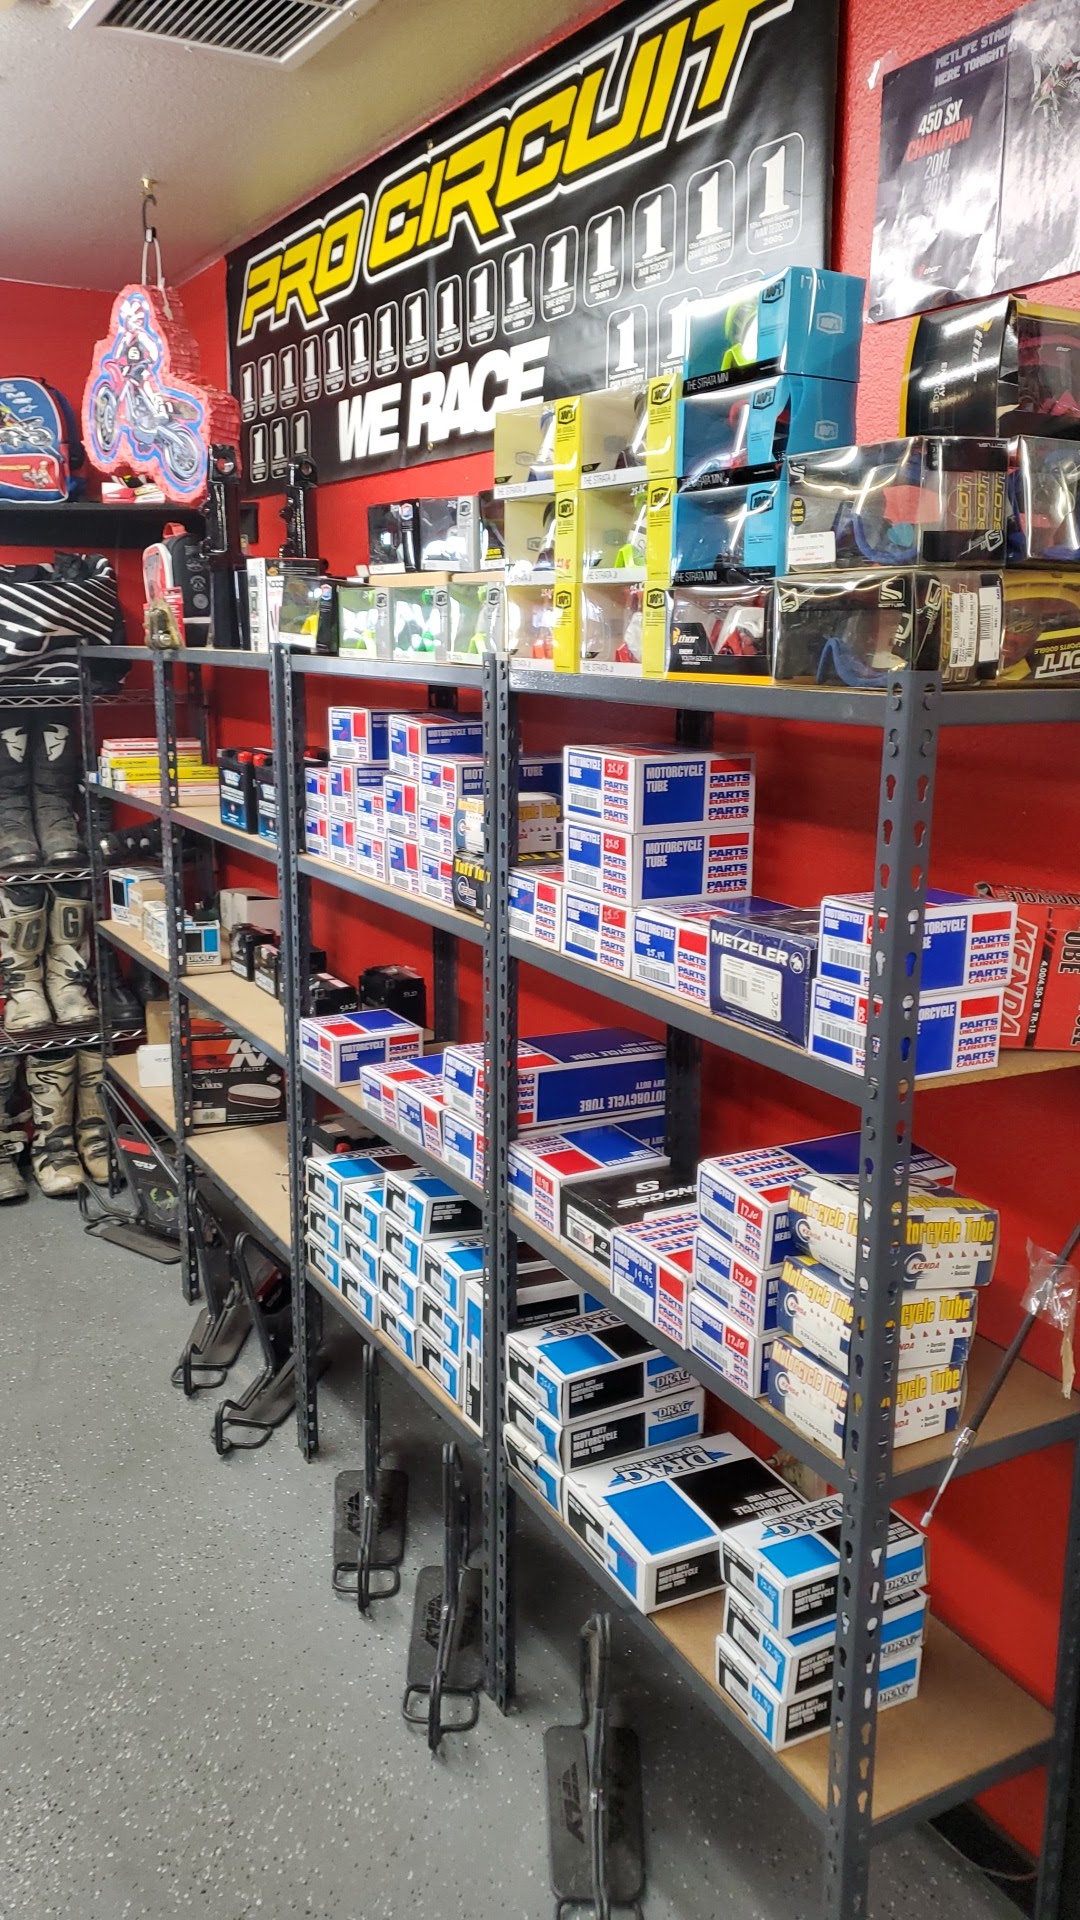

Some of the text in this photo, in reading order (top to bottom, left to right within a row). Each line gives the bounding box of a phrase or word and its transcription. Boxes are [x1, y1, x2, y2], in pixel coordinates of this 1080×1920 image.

[964, 44, 1006, 74] TONIGHT
[918, 99, 963, 136] 450 SX
[906, 117, 973, 161] CHAMPION
[238, 0, 792, 343] PRO CIRCUIT
[924, 149, 951, 180] 2014
[759, 146, 790, 218] 1
[696, 171, 723, 239] 1
[642, 195, 665, 258] 1
[593, 216, 615, 276] 1
[548, 235, 568, 292] 1
[509, 252, 528, 307] 1
[474, 268, 490, 320] 1
[441, 283, 456, 332] 1
[409, 296, 424, 343] 1
[380, 309, 393, 354] 1
[353, 320, 366, 363] 1
[615, 311, 638, 371] 1
[328, 331, 341, 373] 1
[305, 341, 316, 381] 1
[262, 359, 273, 396] 1
[283, 350, 295, 392] 1
[243, 367, 253, 403] 1
[338, 338, 550, 462] WE RACE
[273, 422, 284, 462] 1
[295, 416, 307, 453] 1
[253, 428, 264, 463] 1
[523, 767, 543, 776] TUBE
[646, 764, 703, 779] MOTORCYCLE
[710, 774, 750, 783] PARTS
[646, 780, 668, 792] TUBE
[709, 790, 749, 799] PARTS
[709, 797, 749, 805] EUROPE
[709, 806, 748, 815] PARTS
[645, 840, 702, 855] MOTORCYCLE
[709, 848, 748, 857] PARTS
[645, 856, 667, 868] TUBE
[708, 863, 747, 873] PARTS
[707, 879, 746, 888] PARTS
[707, 886, 746, 894] CANADA
[825, 907, 864, 924] MOTORCYCLE
[825, 918, 839, 930] TUBE
[924, 917, 966, 934] TORCYCLE
[635, 932, 651, 945] TUBE
[971, 934, 1010, 945] PARTS
[971, 942, 1009, 951] UNLIMITED
[711, 929, 789, 966] METZELER
[678, 951, 706, 966] PARTS
[970, 951, 1009, 962] PARTS
[970, 959, 1008, 968] EUROPE
[678, 966, 706, 981] PARTS
[968, 975, 1007, 985] CANADA
[969, 967, 1008, 979] PARTS
[1001, 918, 1038, 1037] KENDA
[678, 981, 706, 996] PARTS
[817, 986, 855, 1006] MOTORCYCLE
[816, 998, 832, 1009] TUBE
[919, 1004, 955, 1021] ORCYCLE
[959, 1025, 999, 1035] UNLIMITED
[960, 1018, 999, 1029] PARTS
[341, 1040, 385, 1053] MOTORCYCLE
[957, 1043, 997, 1053] EUROPE
[958, 1035, 997, 1047] PARTS
[341, 1053, 359, 1062] TUBE
[956, 1059, 995, 1069] CANADA
[957, 1051, 995, 1063] PARTS
[580, 1099, 604, 1112] TUBE
[719, 1151, 784, 1167] PARTS
[735, 1161, 798, 1177] PARTS
[789, 1189, 846, 1229] Motorcycle
[906, 1216, 994, 1247] torcycle Tube
[614, 1237, 653, 1273] MOTORCYCLE
[614, 1252, 629, 1270] TUBE
[911, 1262, 940, 1270] KENDA
[782, 1261, 831, 1309] Motorcycle
[831, 1294, 854, 1324] Tube
[901, 1298, 970, 1329] cycle Tube
[655, 1370, 691, 1387] DRAG
[772, 1339, 822, 1391] Motorcycle
[824, 1375, 847, 1407] Tube
[897, 1370, 960, 1407] cycle Tube
[658, 1401, 691, 1418] DRAG
[573, 1426, 607, 1441] HEAVY DUTY
[573, 1431, 618, 1449] MOTORCYCLE
[573, 1444, 605, 1458] INNER TUBE
[623, 1451, 717, 1484] DRAG
[732, 1493, 798, 1516] MOTORCYCLE
[659, 1563, 690, 1577] HEAVY DUTY
[659, 1567, 698, 1585] MOTORCYCLE
[674, 1579, 687, 1589] TUBE
[812, 1583, 825, 1592] DUTY
[885, 1572, 918, 1591] DRAG
[795, 1587, 834, 1607] MOTORCYCLE
[885, 1636, 917, 1654] DRAG
[879, 1685, 910, 1703] DRAG
[789, 1701, 827, 1722] MOTORCYCLE
